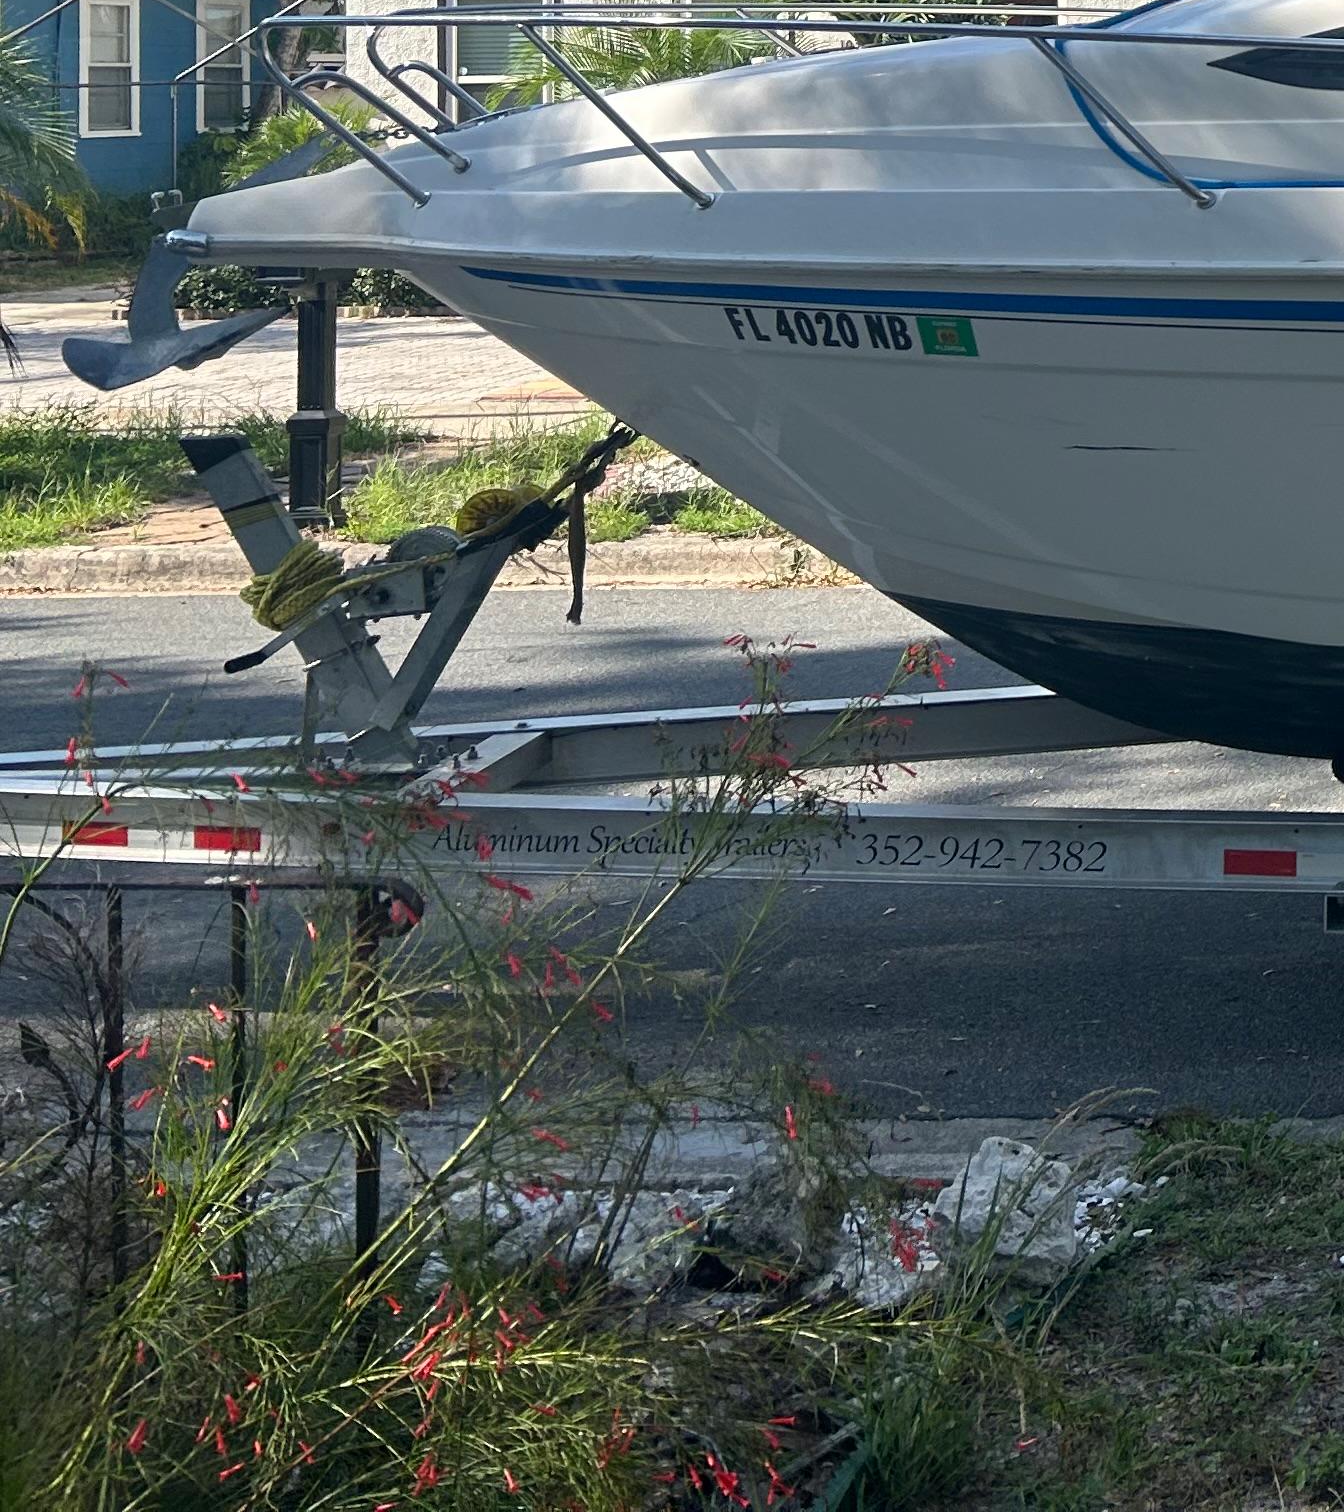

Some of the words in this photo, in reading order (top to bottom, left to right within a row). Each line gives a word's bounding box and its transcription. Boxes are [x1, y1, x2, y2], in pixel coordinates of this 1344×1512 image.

[723, 307, 771, 342] FL
[776, 309, 860, 349] 4020
[863, 314, 913, 351] NB
[712, 824, 808, 858] railers
[856, 833, 1108, 873] 352-942-7382
